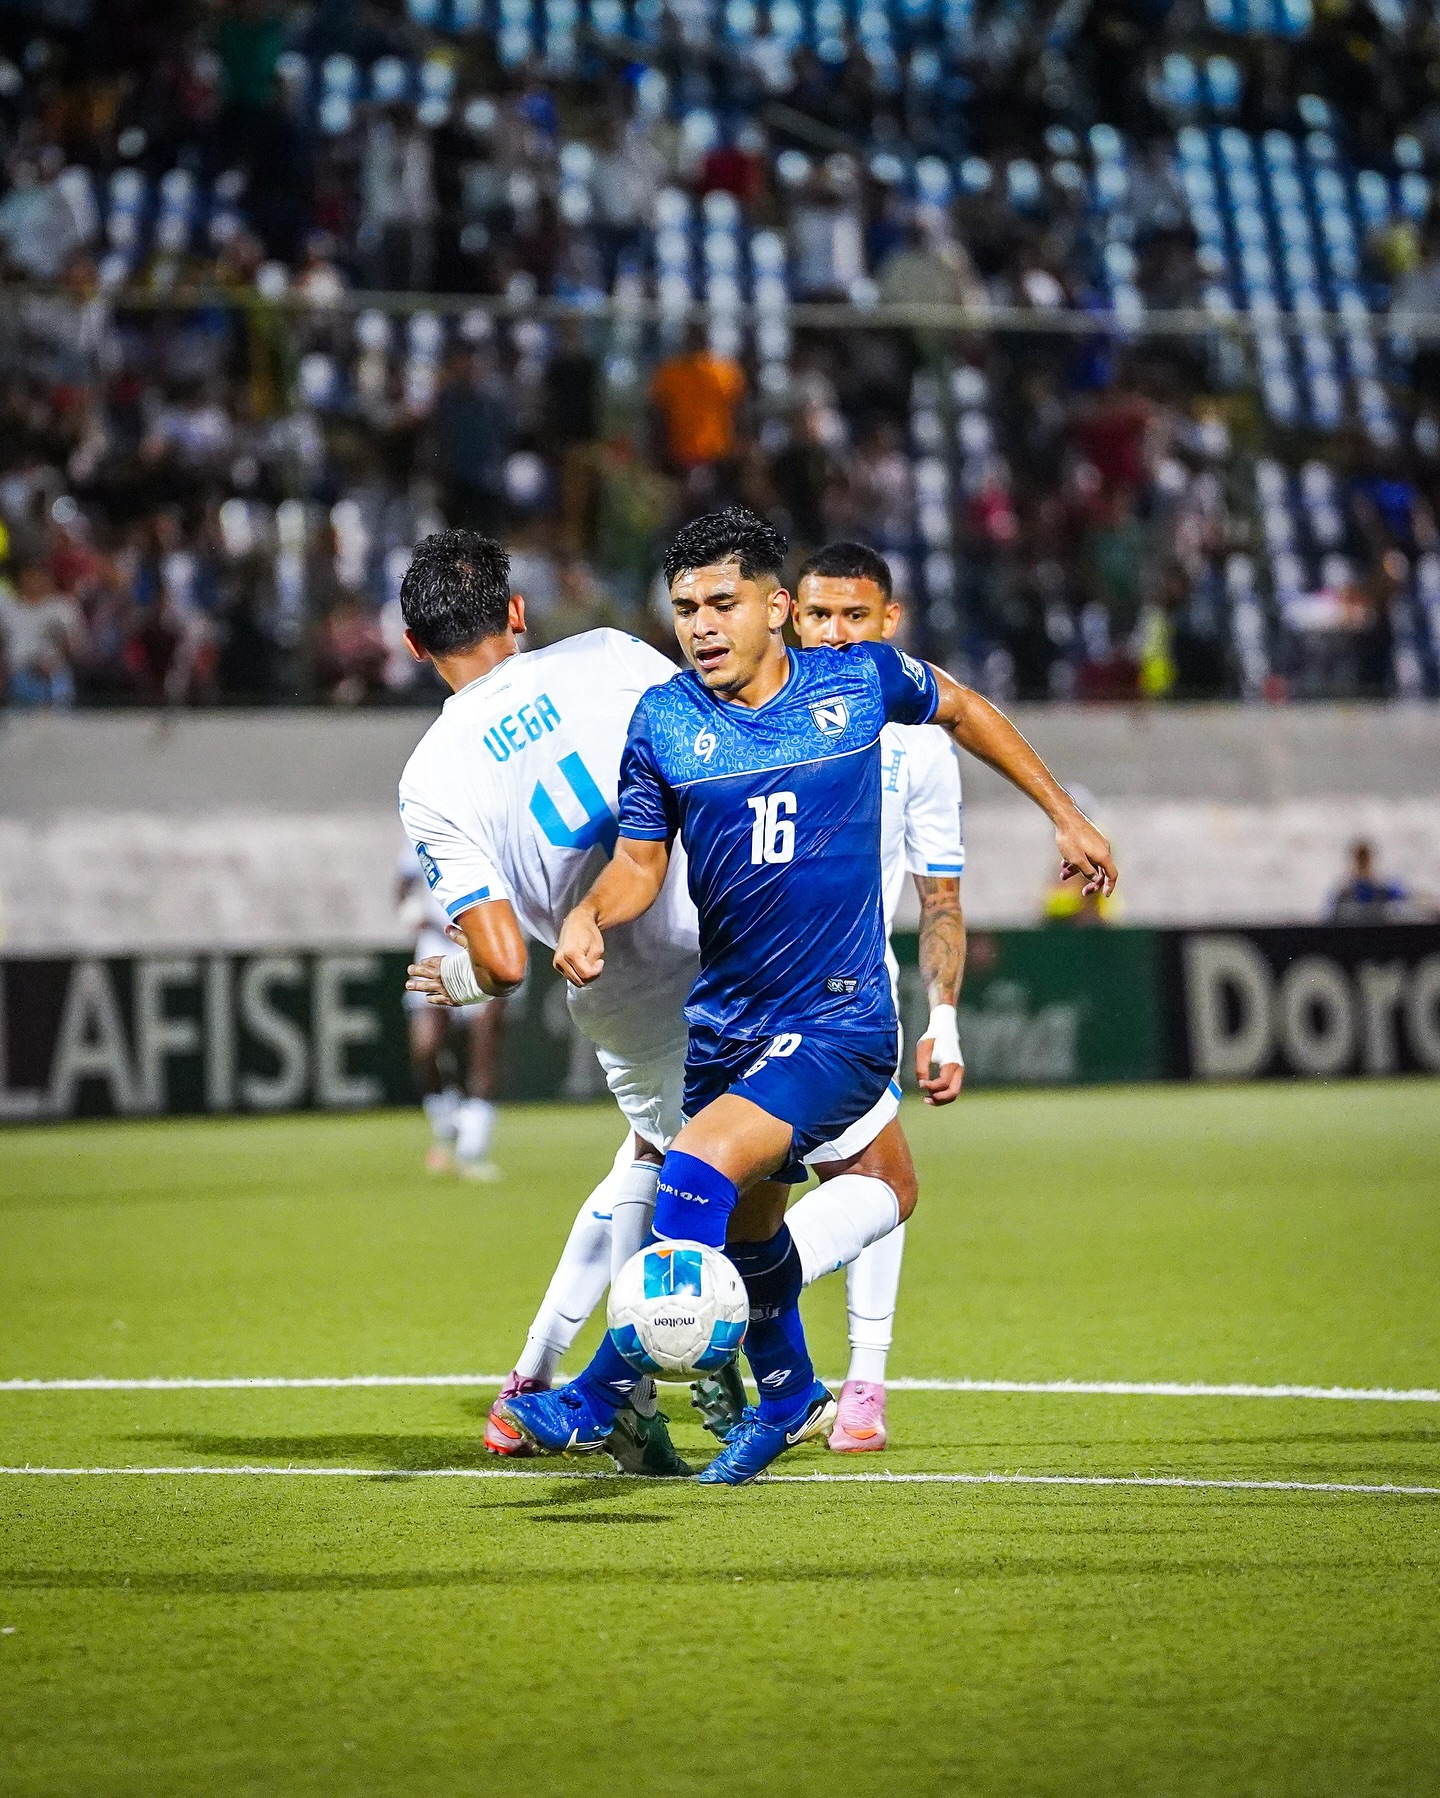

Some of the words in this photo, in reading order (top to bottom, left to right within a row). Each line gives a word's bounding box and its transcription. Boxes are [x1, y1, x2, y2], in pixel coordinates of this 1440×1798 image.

[529, 751, 620, 861] 4
[747, 791, 797, 865] 16
[653, 1317, 695, 1328] molten
